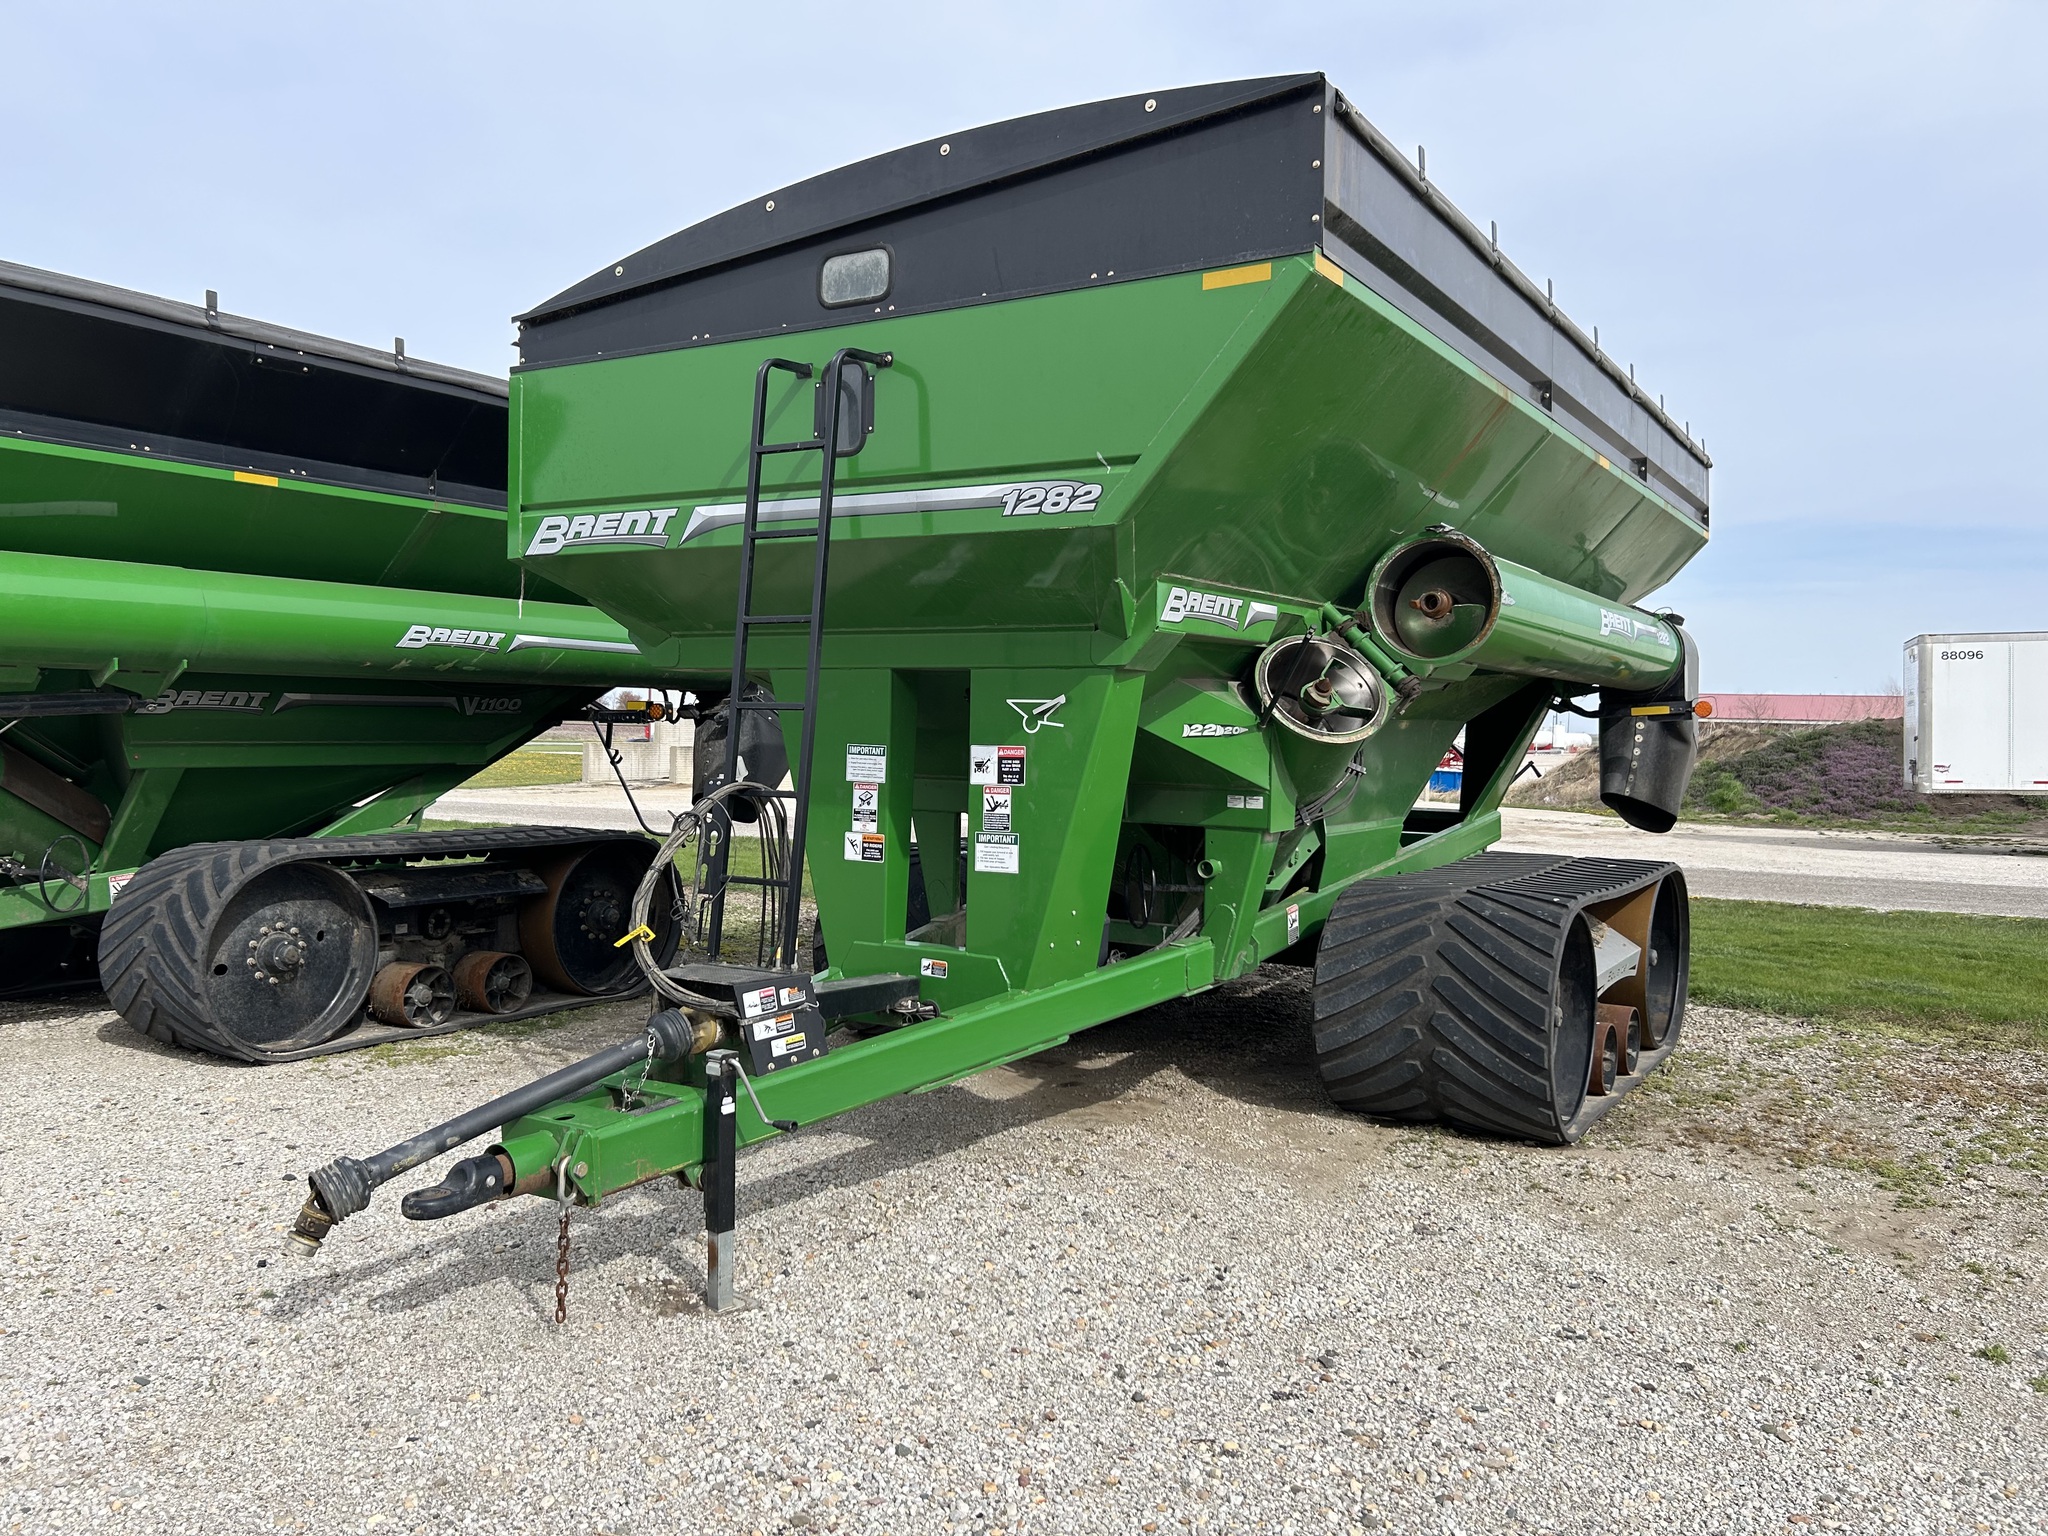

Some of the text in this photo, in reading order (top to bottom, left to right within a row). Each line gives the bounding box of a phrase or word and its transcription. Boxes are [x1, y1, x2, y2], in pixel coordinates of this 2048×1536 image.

[524, 483, 1104, 556] BRENT 1282
[1160, 586, 1243, 623] BRENT
[1600, 608, 1633, 636] BRENT
[395, 624, 507, 649] BRENT
[1941, 650, 1984, 660] 88096
[134, 688, 522, 716] BRENT V1100
[849, 746, 885, 755] IMPORTANT
[978, 834, 1015, 844] IMPORTANT
